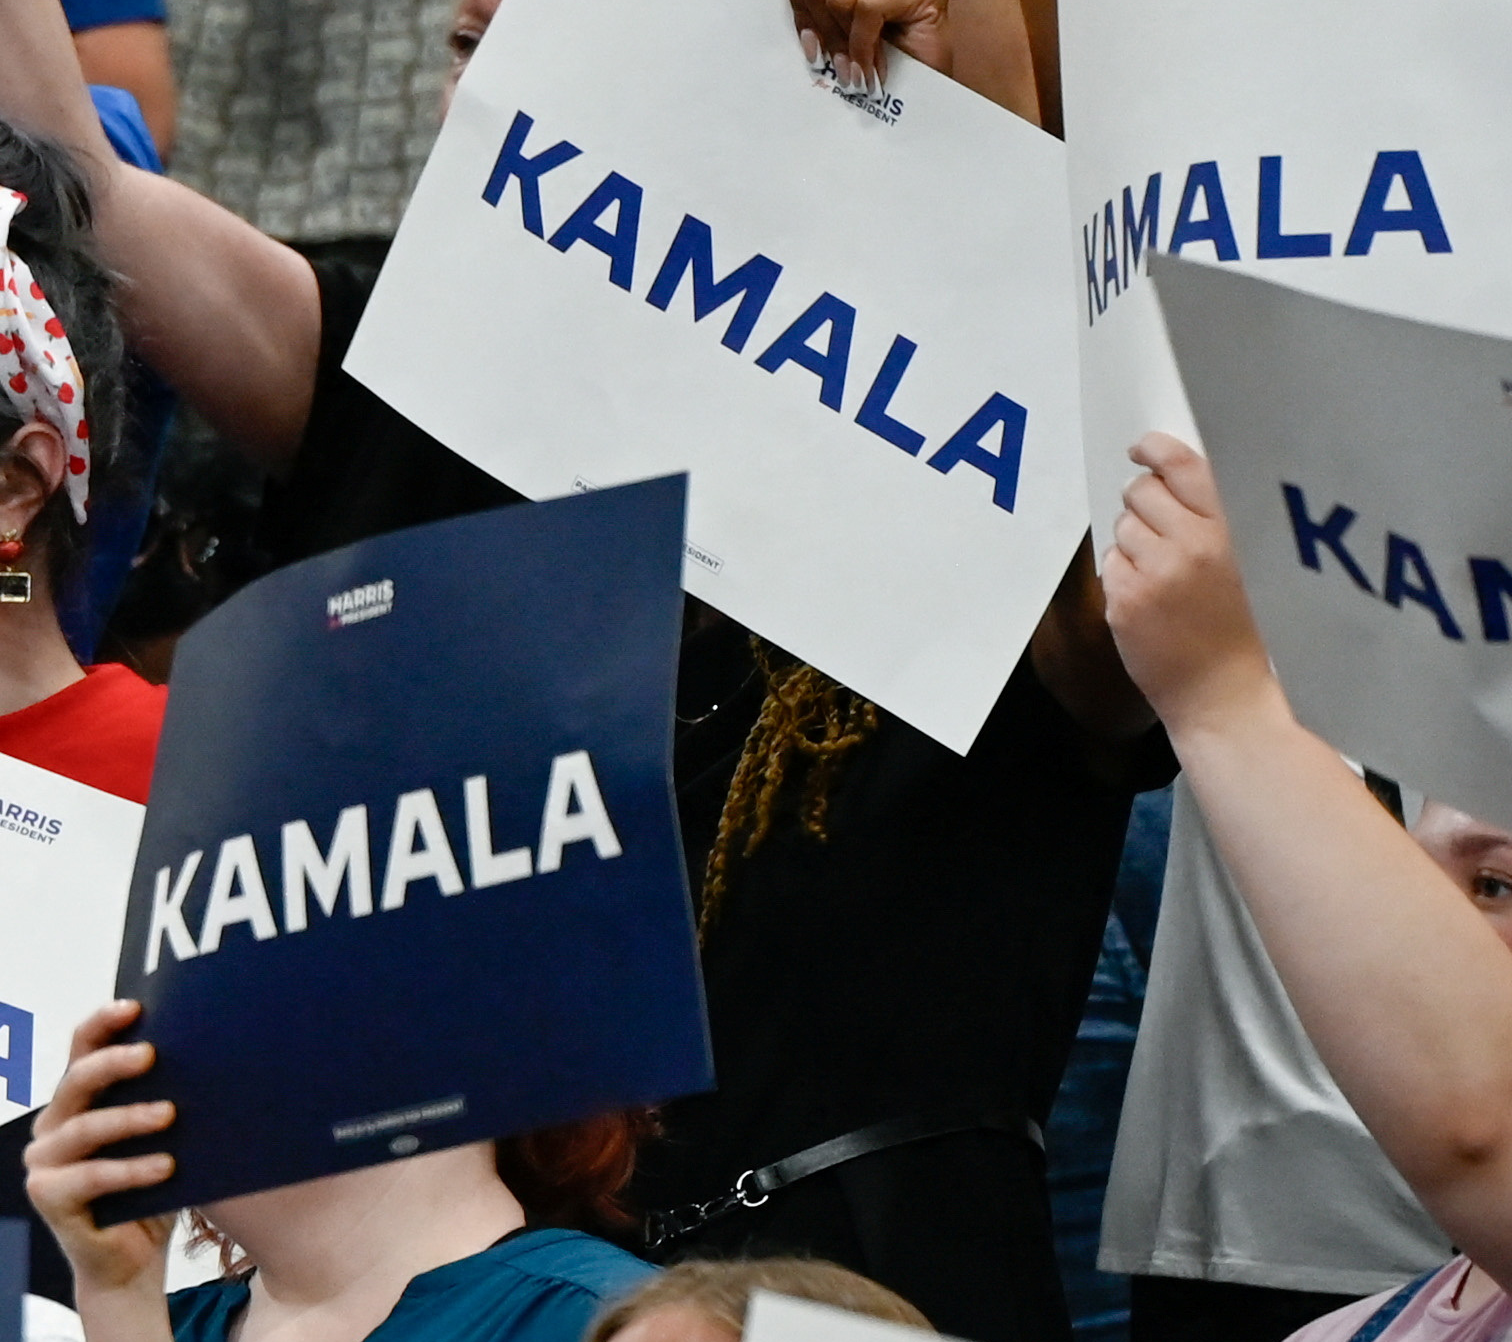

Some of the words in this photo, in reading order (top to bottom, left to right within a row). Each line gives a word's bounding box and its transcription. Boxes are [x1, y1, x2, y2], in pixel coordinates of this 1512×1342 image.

[481, 109, 1028, 514] KAMALA
[1083, 150, 1453, 327] KAMALA
[327, 578, 395, 619] HARRIS
[144, 750, 624, 976] KAMALA
